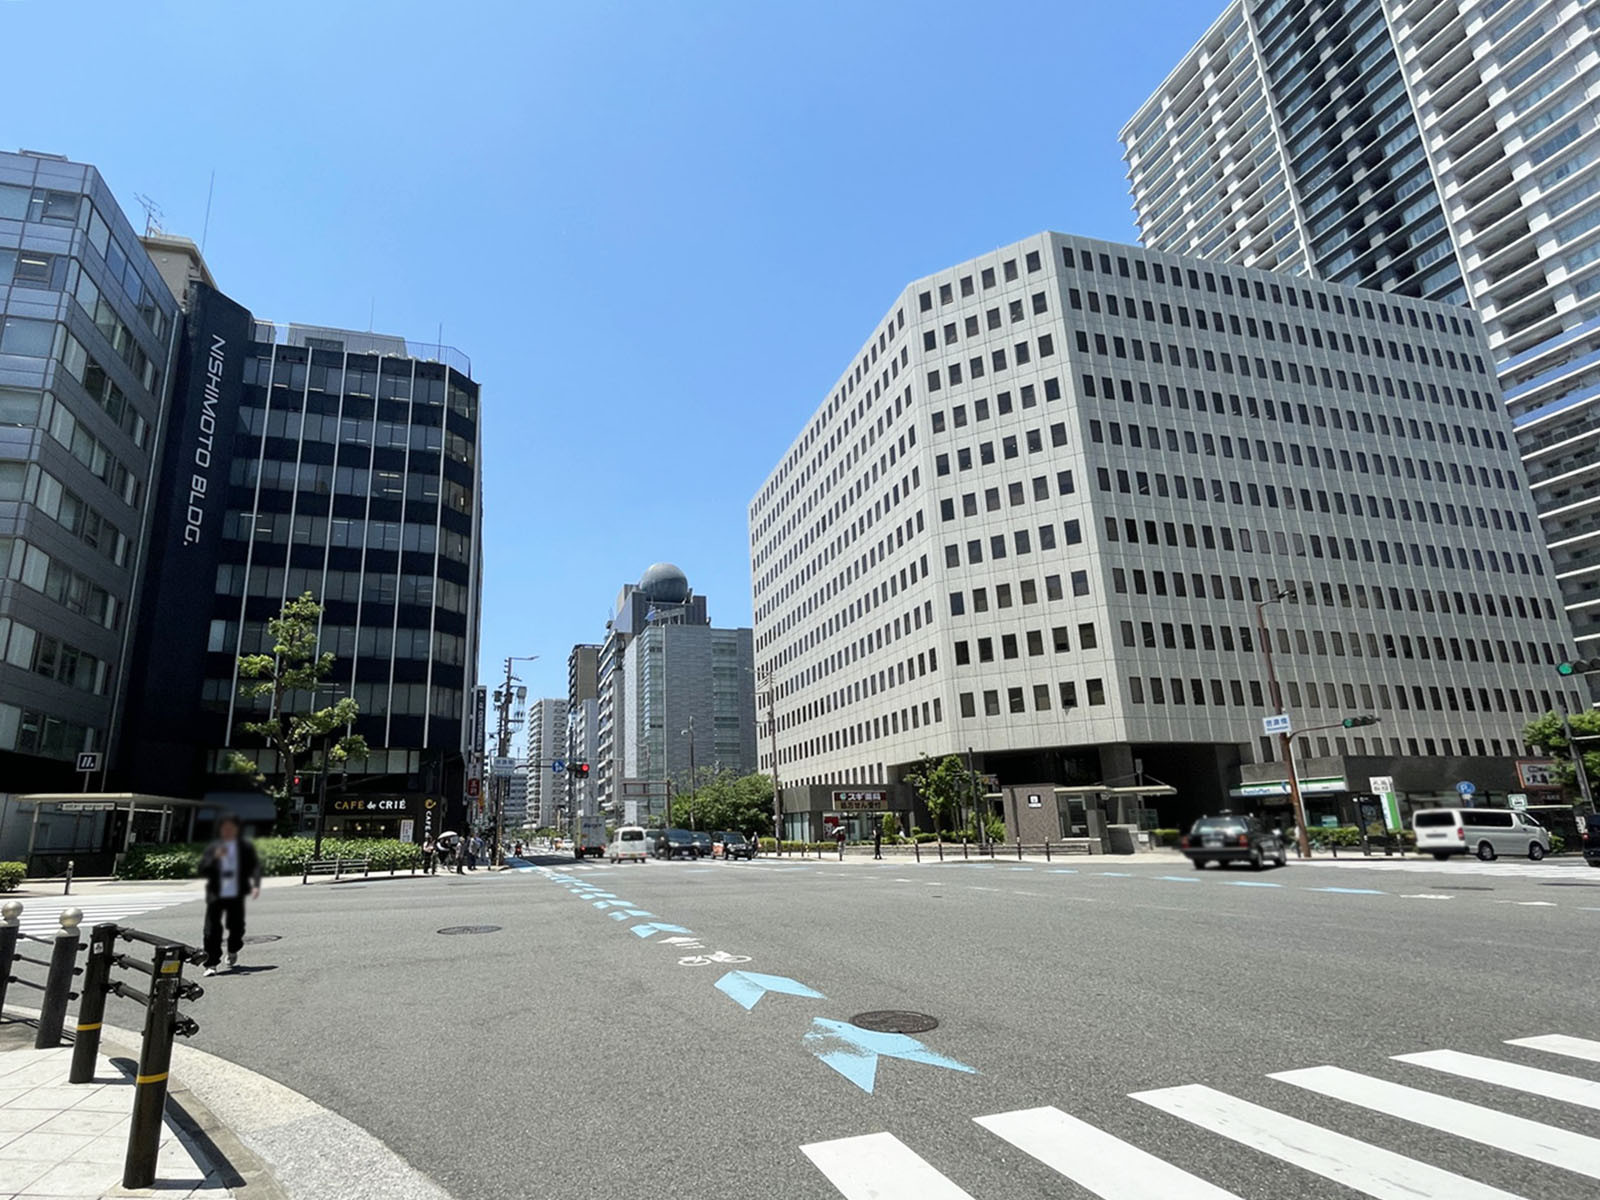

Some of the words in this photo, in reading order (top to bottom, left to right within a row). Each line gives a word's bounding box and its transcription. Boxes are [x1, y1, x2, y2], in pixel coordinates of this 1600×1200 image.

[195, 334, 226, 468] NISHIMOTO
[183, 474, 207, 546] BLDG.
[379, 799, 406, 809] CRIÉ
